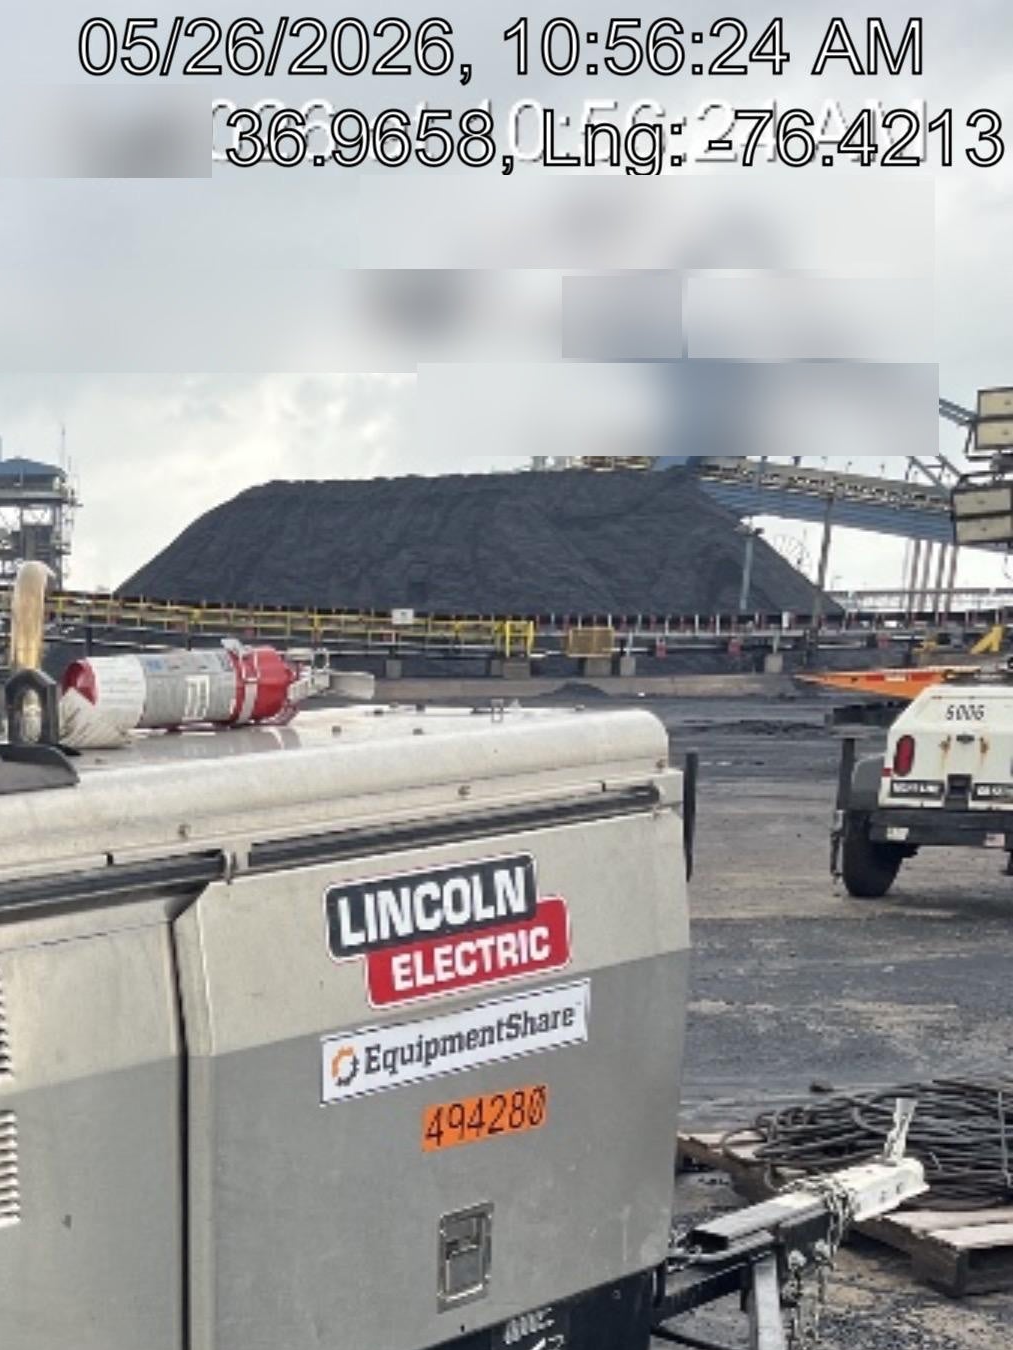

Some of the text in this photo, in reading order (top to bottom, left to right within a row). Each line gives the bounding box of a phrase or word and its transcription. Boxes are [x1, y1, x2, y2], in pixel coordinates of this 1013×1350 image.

[338, 866, 529, 947] LINCOLN
[391, 926, 551, 992] ELECTRIC
[364, 1006, 576, 1077] EquipmentShare
[424, 1085, 547, 1147] 494280
